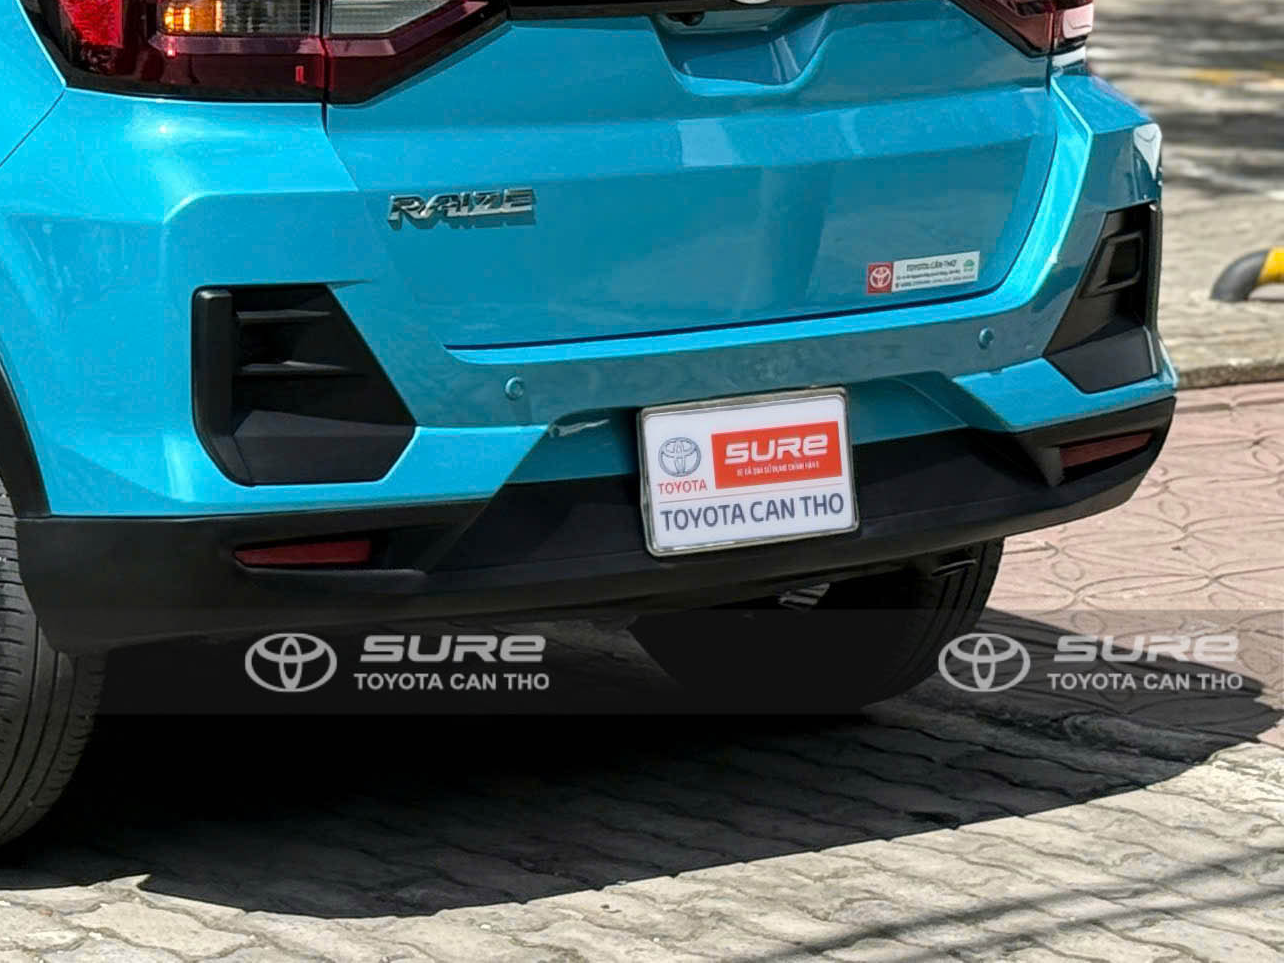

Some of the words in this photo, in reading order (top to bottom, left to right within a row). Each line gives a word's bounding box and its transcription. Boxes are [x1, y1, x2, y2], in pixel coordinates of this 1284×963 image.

[388, 186, 535, 225] RAIZE
[658, 479, 708, 496] TOYOTA
[660, 503, 746, 531] TOYOTA
[750, 498, 796, 524] CAN
[799, 493, 845, 518] THO
